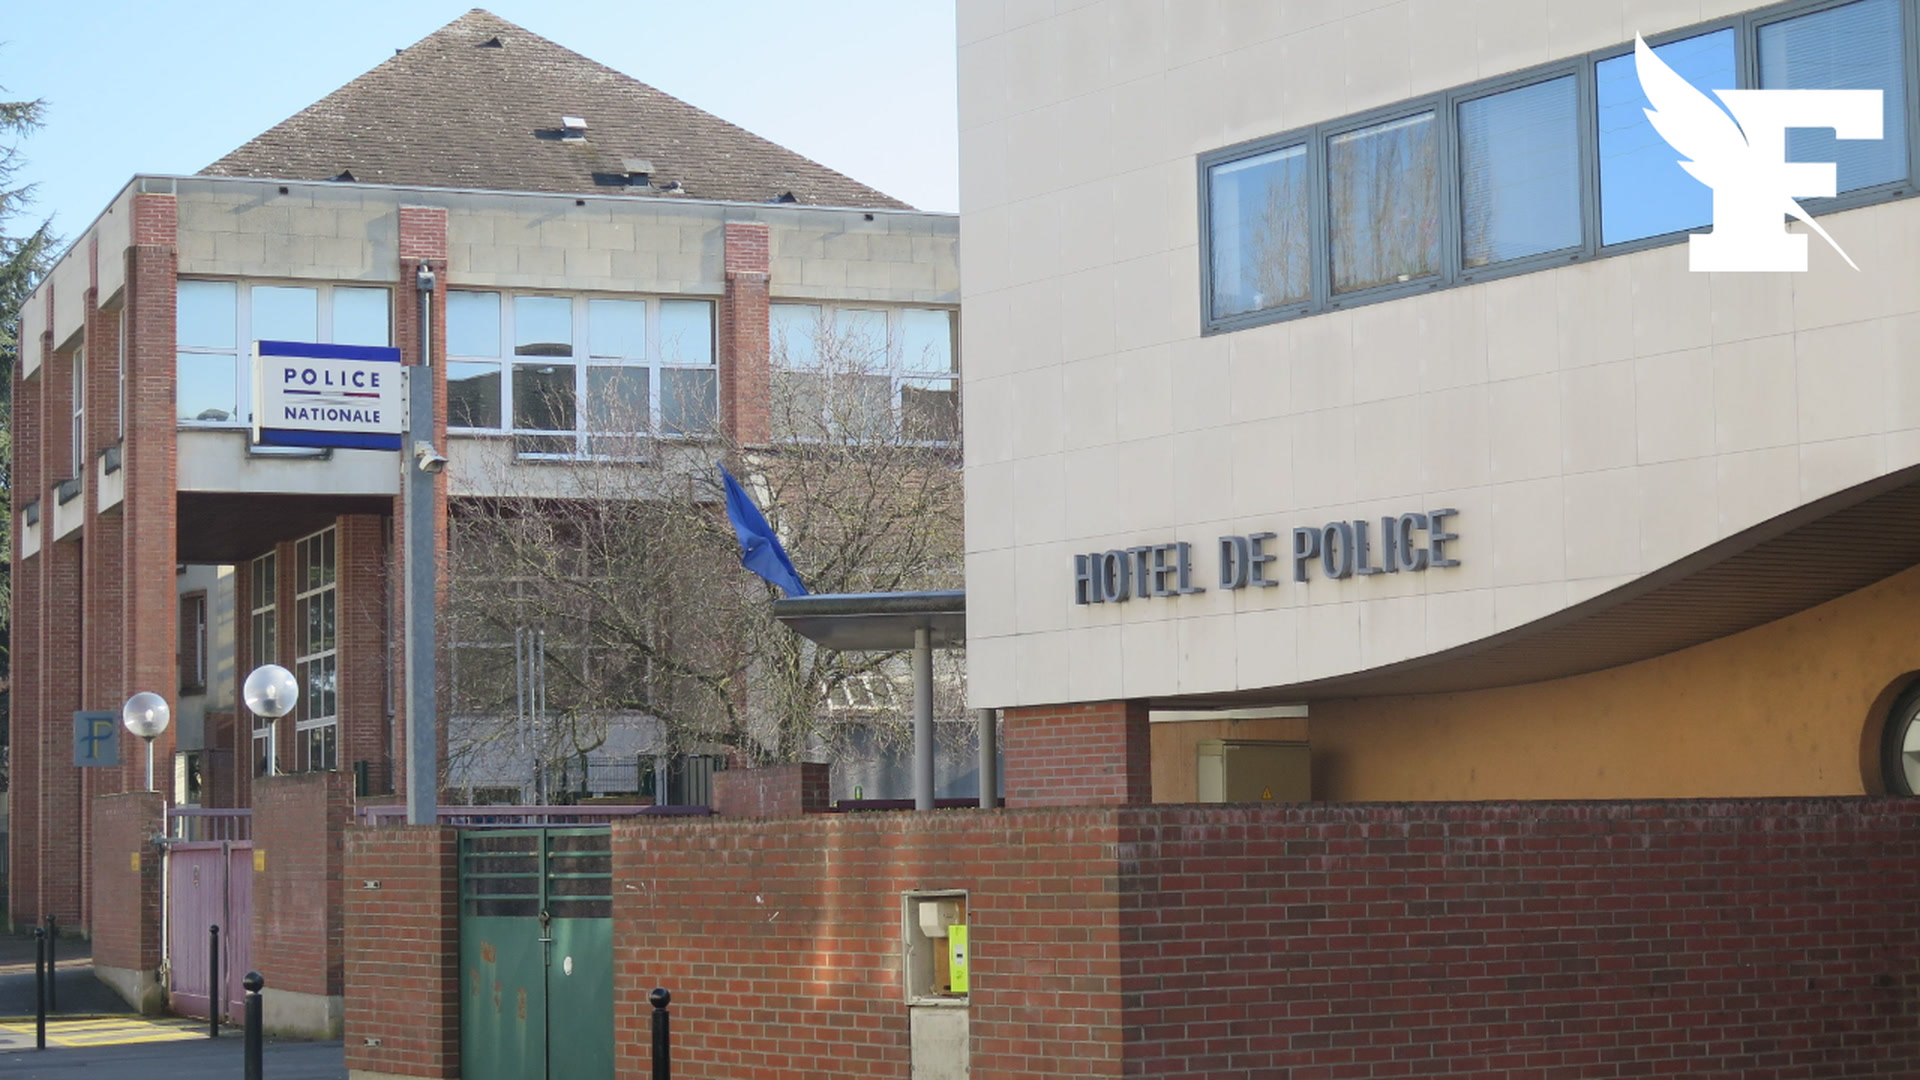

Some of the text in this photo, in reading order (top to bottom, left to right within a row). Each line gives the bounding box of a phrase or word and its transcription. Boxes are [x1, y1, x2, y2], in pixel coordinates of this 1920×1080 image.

[284, 368, 380, 388] POLICE
[284, 406, 381, 424] NATIONALE
[1074, 508, 1461, 605] HOTEL DE POLICE
